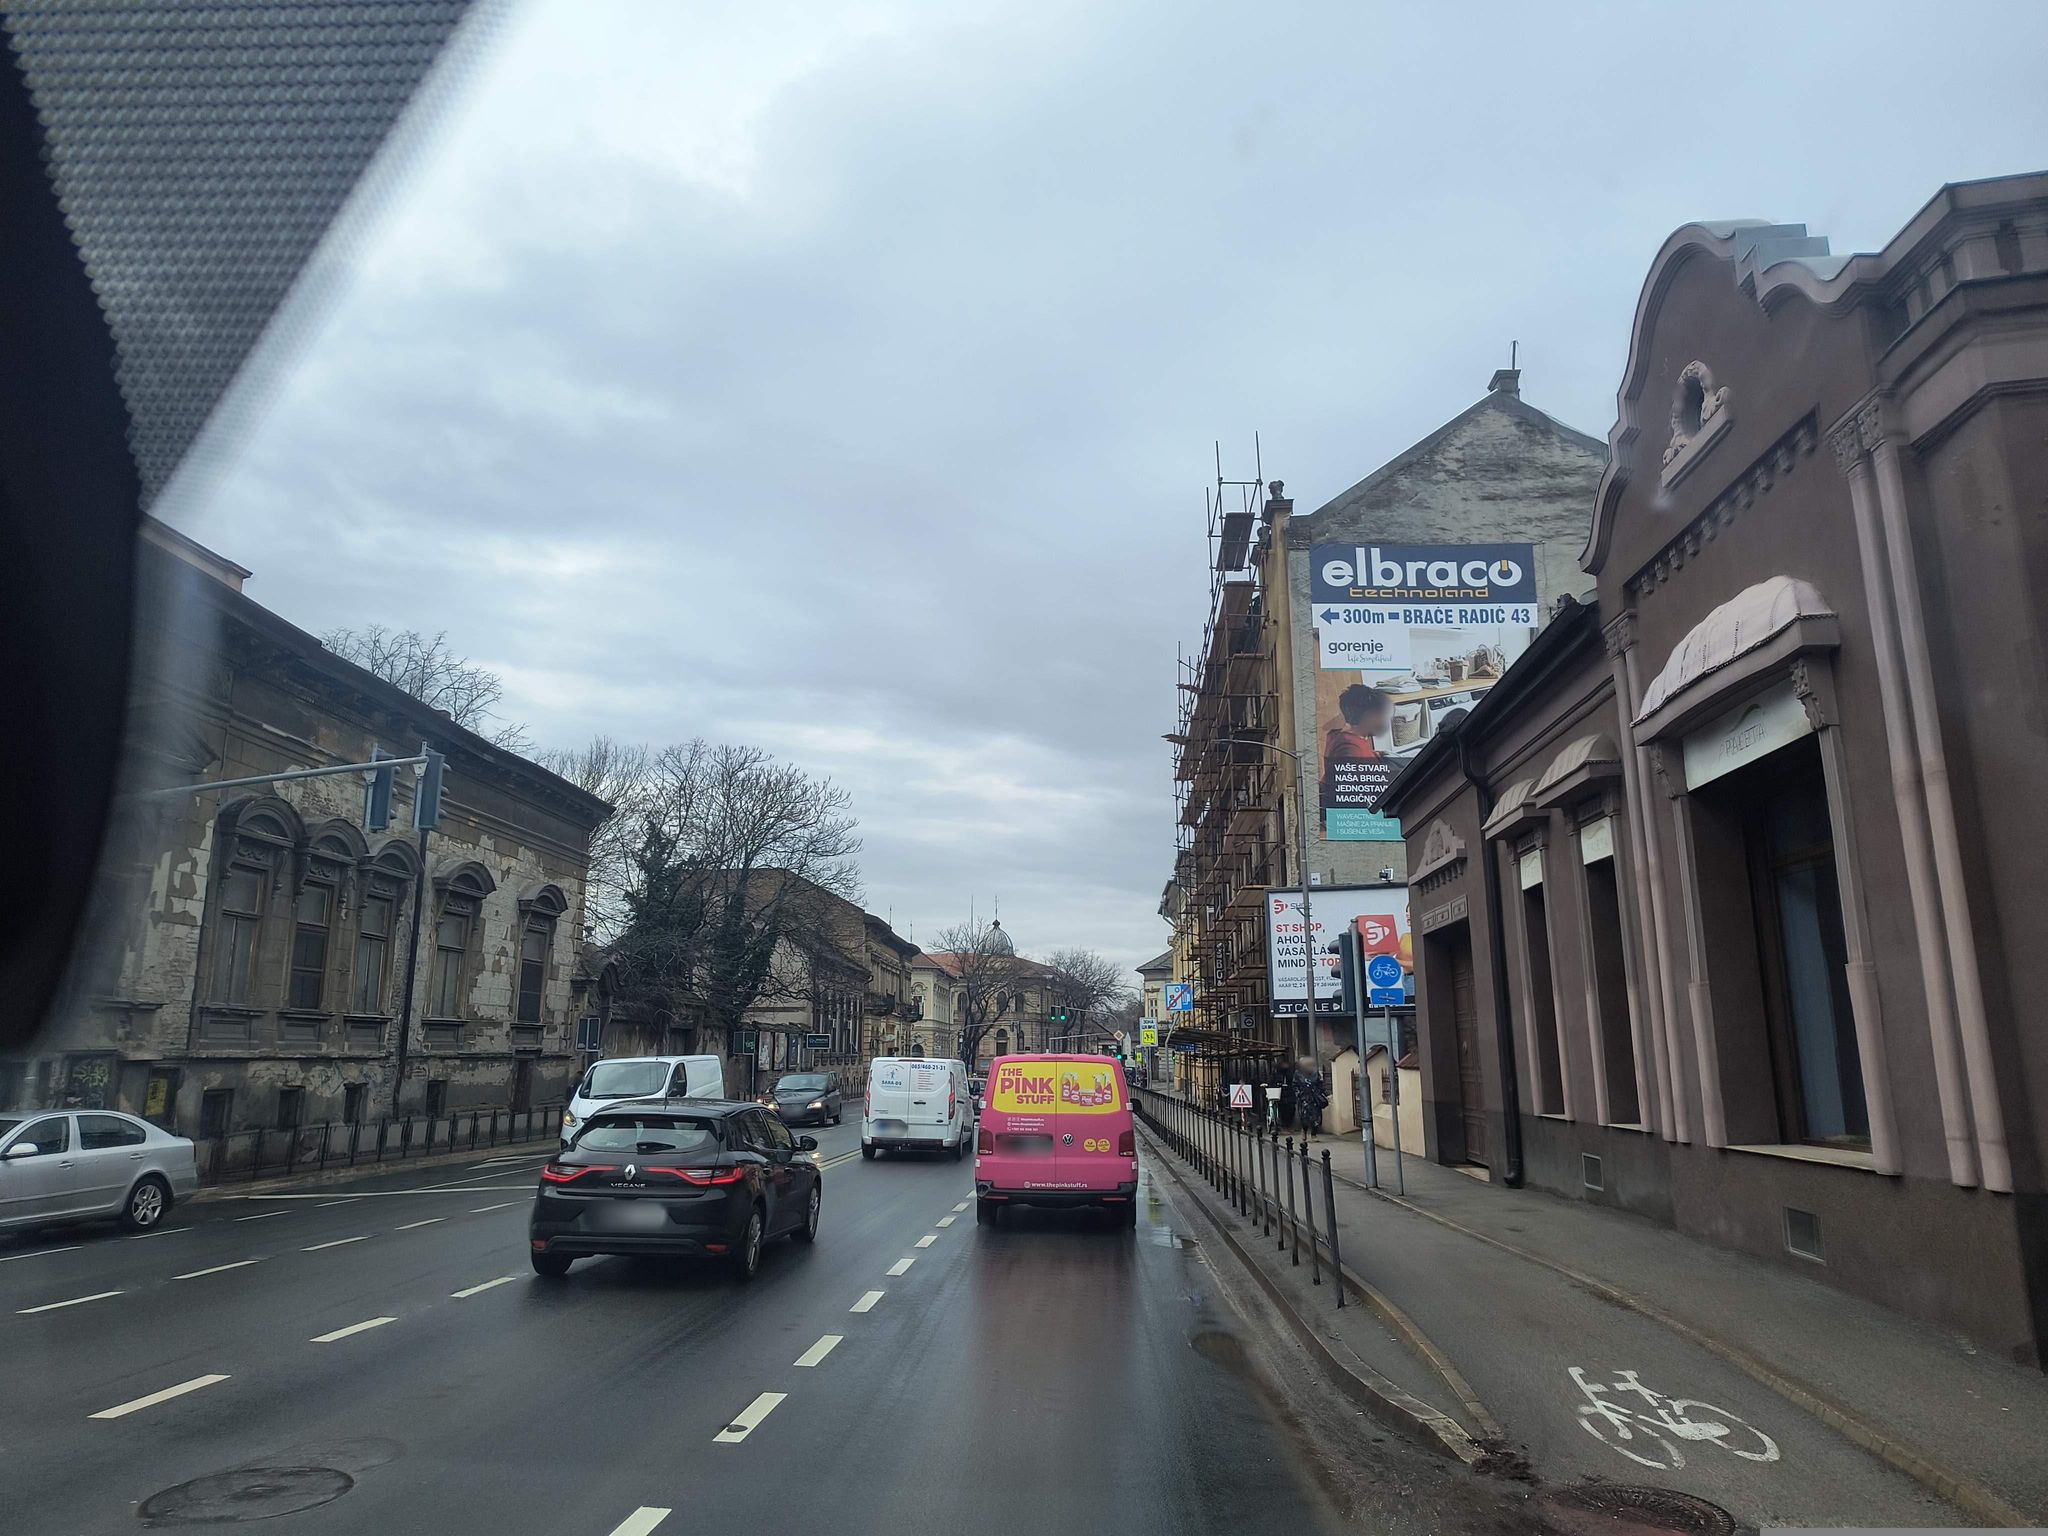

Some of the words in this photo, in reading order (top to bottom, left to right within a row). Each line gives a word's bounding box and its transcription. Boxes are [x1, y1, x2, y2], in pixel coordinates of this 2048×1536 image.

[1322, 547, 1522, 587] elbraco
[1350, 587, 1489, 598] technoland
[1343, 608, 1385, 624] 300m
[1459, 606, 1506, 624] RADIĆ
[1511, 608, 1530, 624] 43
[1328, 639, 1384, 655] gorenje
[1334, 763, 1357, 772] VAŠE
[1358, 764, 1390, 773] STVARI,
[1335, 773, 1358, 782] NAŠA
[1276, 924, 1289, 932] ST
[1277, 935, 1306, 945] AHOL
[1277, 944, 1332, 956] VÁSÁLÁ
[1278, 958, 1317, 968] MINDG
[1279, 1003, 1293, 1012] ST
[1295, 1002, 1329, 1012] CALE
[1001, 1068, 1022, 1076] THE
[1000, 1077, 1054, 1094] PINK
[1016, 1095, 1054, 1104] STUFF
